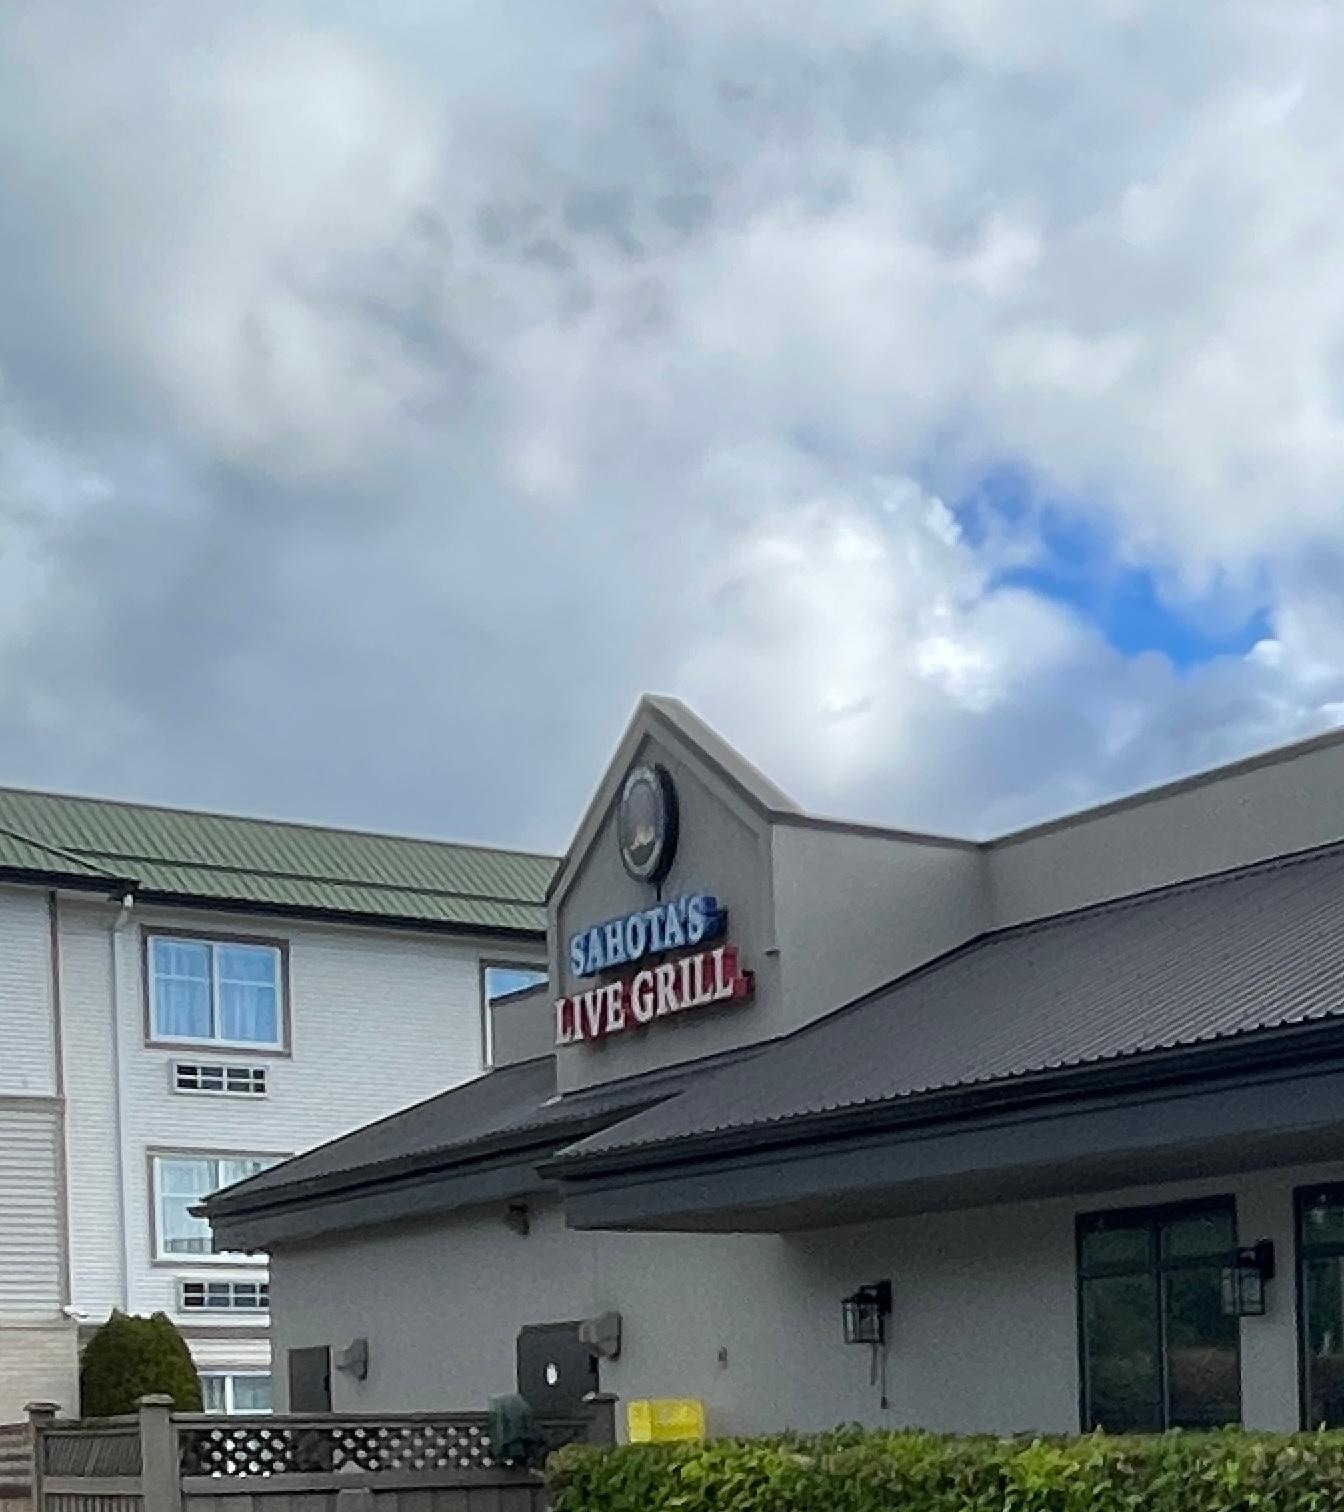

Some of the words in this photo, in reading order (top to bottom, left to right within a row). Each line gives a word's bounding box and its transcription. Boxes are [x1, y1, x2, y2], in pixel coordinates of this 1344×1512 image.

[570, 896, 706, 977] SAHOTA'S
[554, 981, 626, 1045] LIVE
[630, 945, 734, 1024] GRILL
